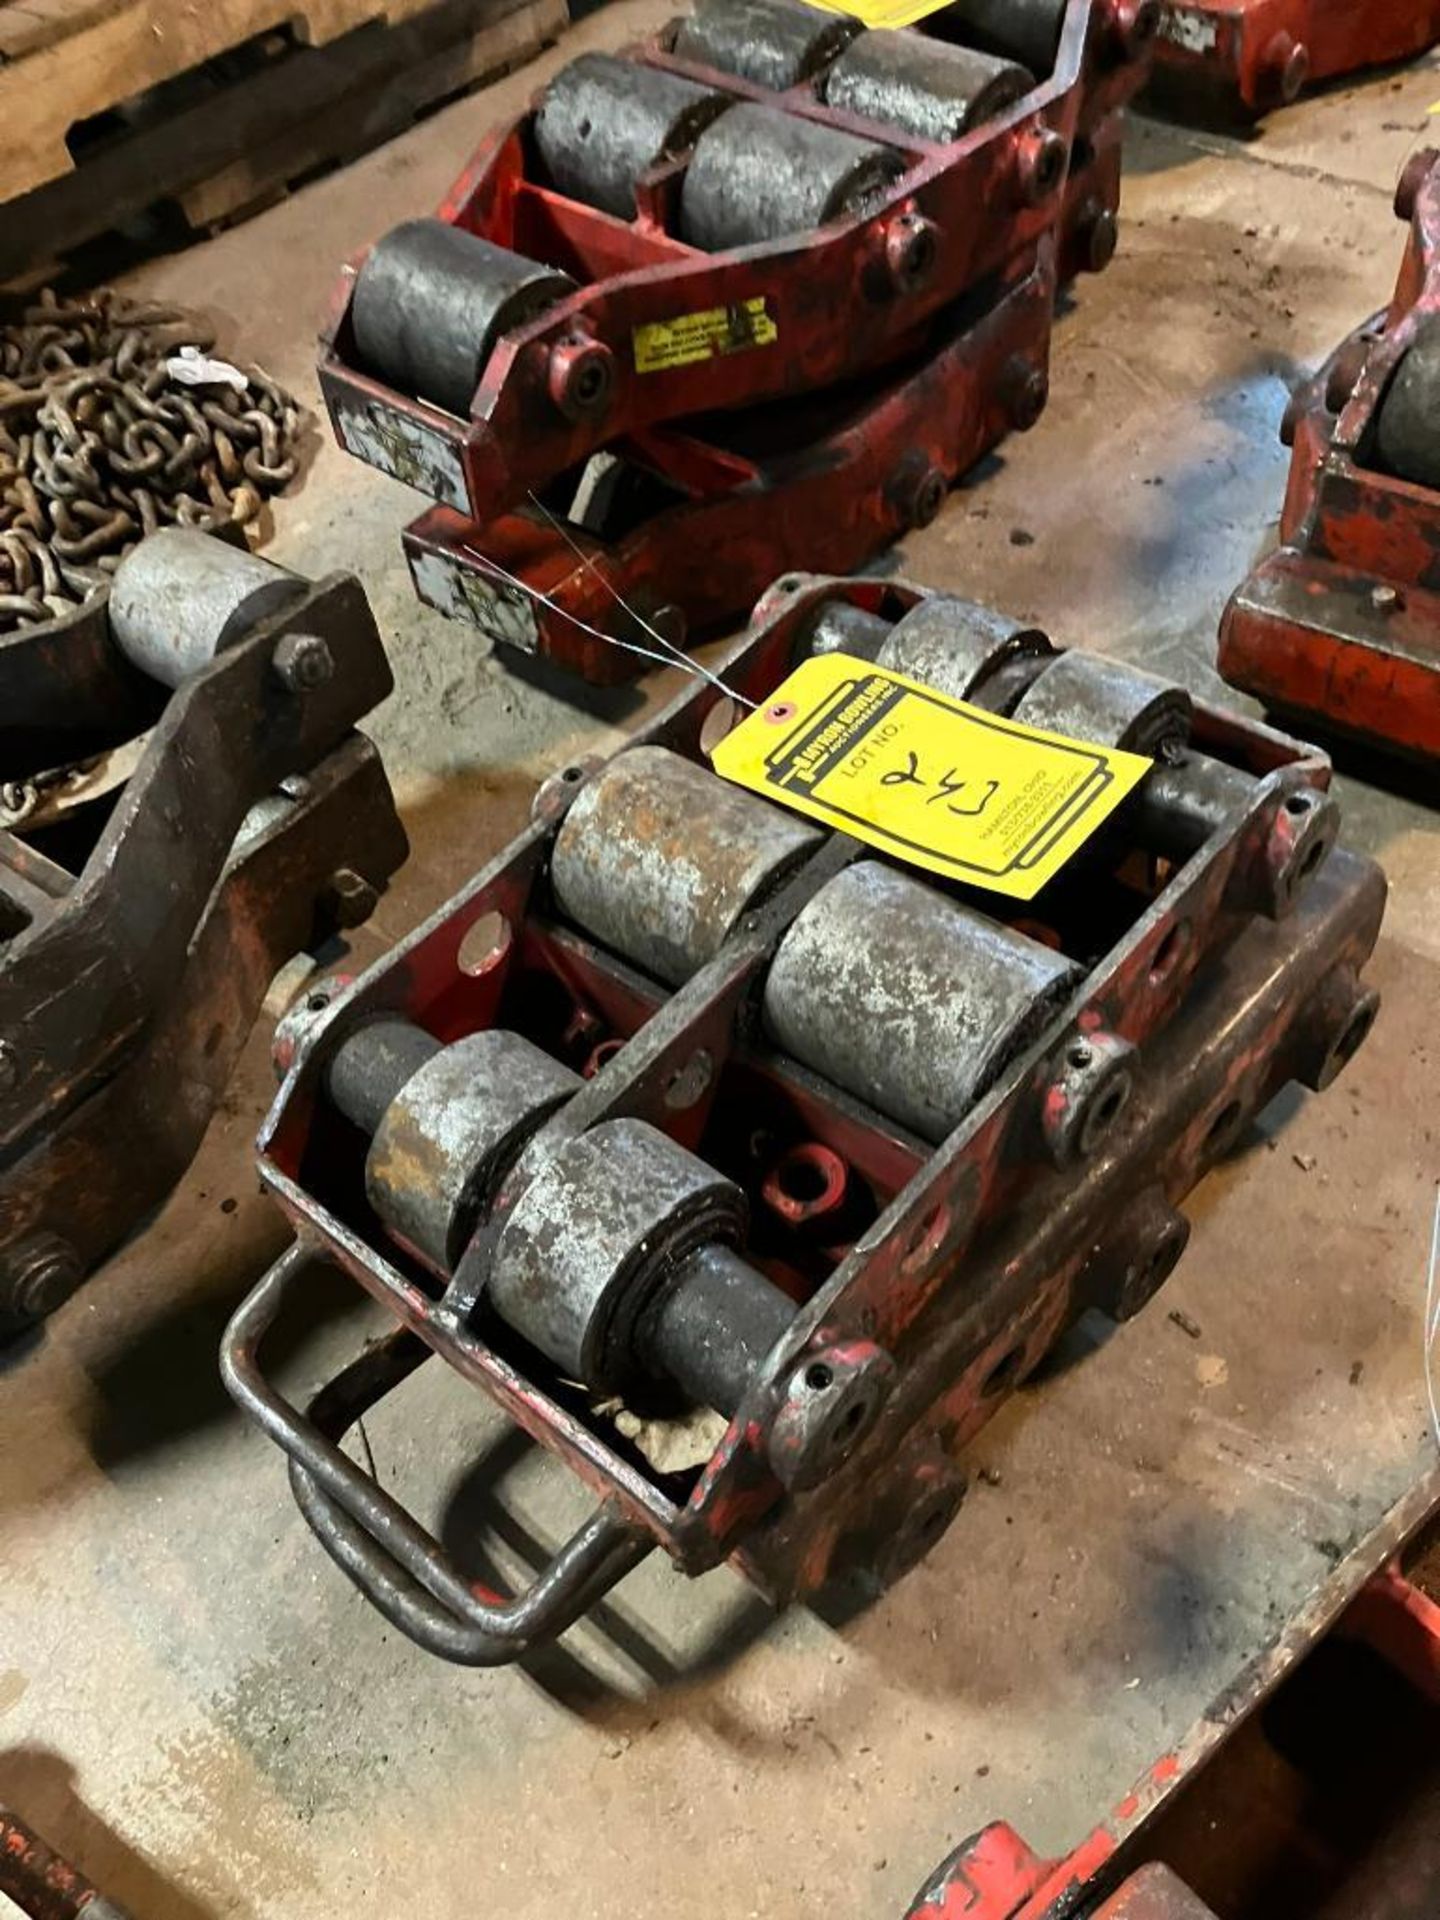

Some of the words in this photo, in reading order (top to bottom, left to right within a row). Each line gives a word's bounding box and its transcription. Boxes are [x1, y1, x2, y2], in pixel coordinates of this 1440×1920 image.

[801, 720, 846, 762] MYRON
[837, 677, 891, 727] BOWLING
[841, 747, 876, 779] LOT
[871, 723, 906, 749] NO.
[1023, 769, 1047, 793] OHIO
